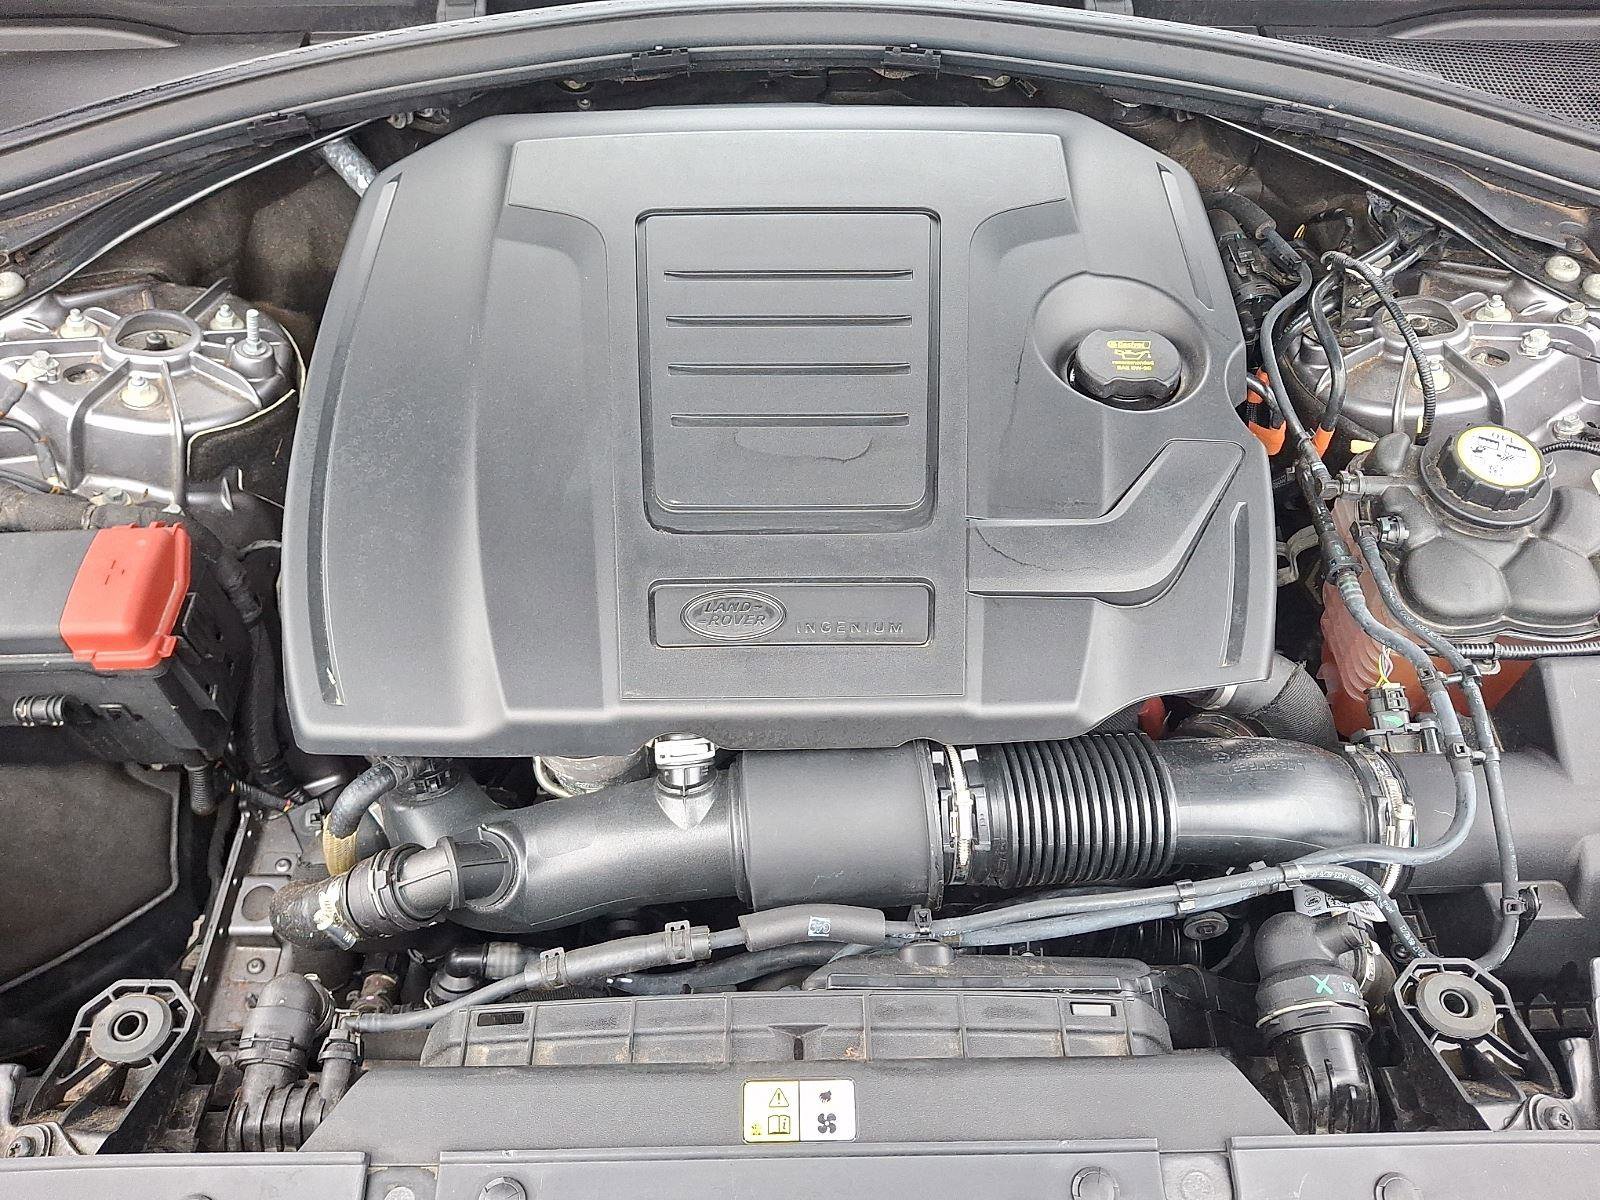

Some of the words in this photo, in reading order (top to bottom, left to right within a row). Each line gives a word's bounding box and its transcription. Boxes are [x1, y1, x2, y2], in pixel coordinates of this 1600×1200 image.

[704, 600, 752, 613] LAND
[708, 614, 766, 628] ROVER
[795, 621, 905, 635] INGENIUM
